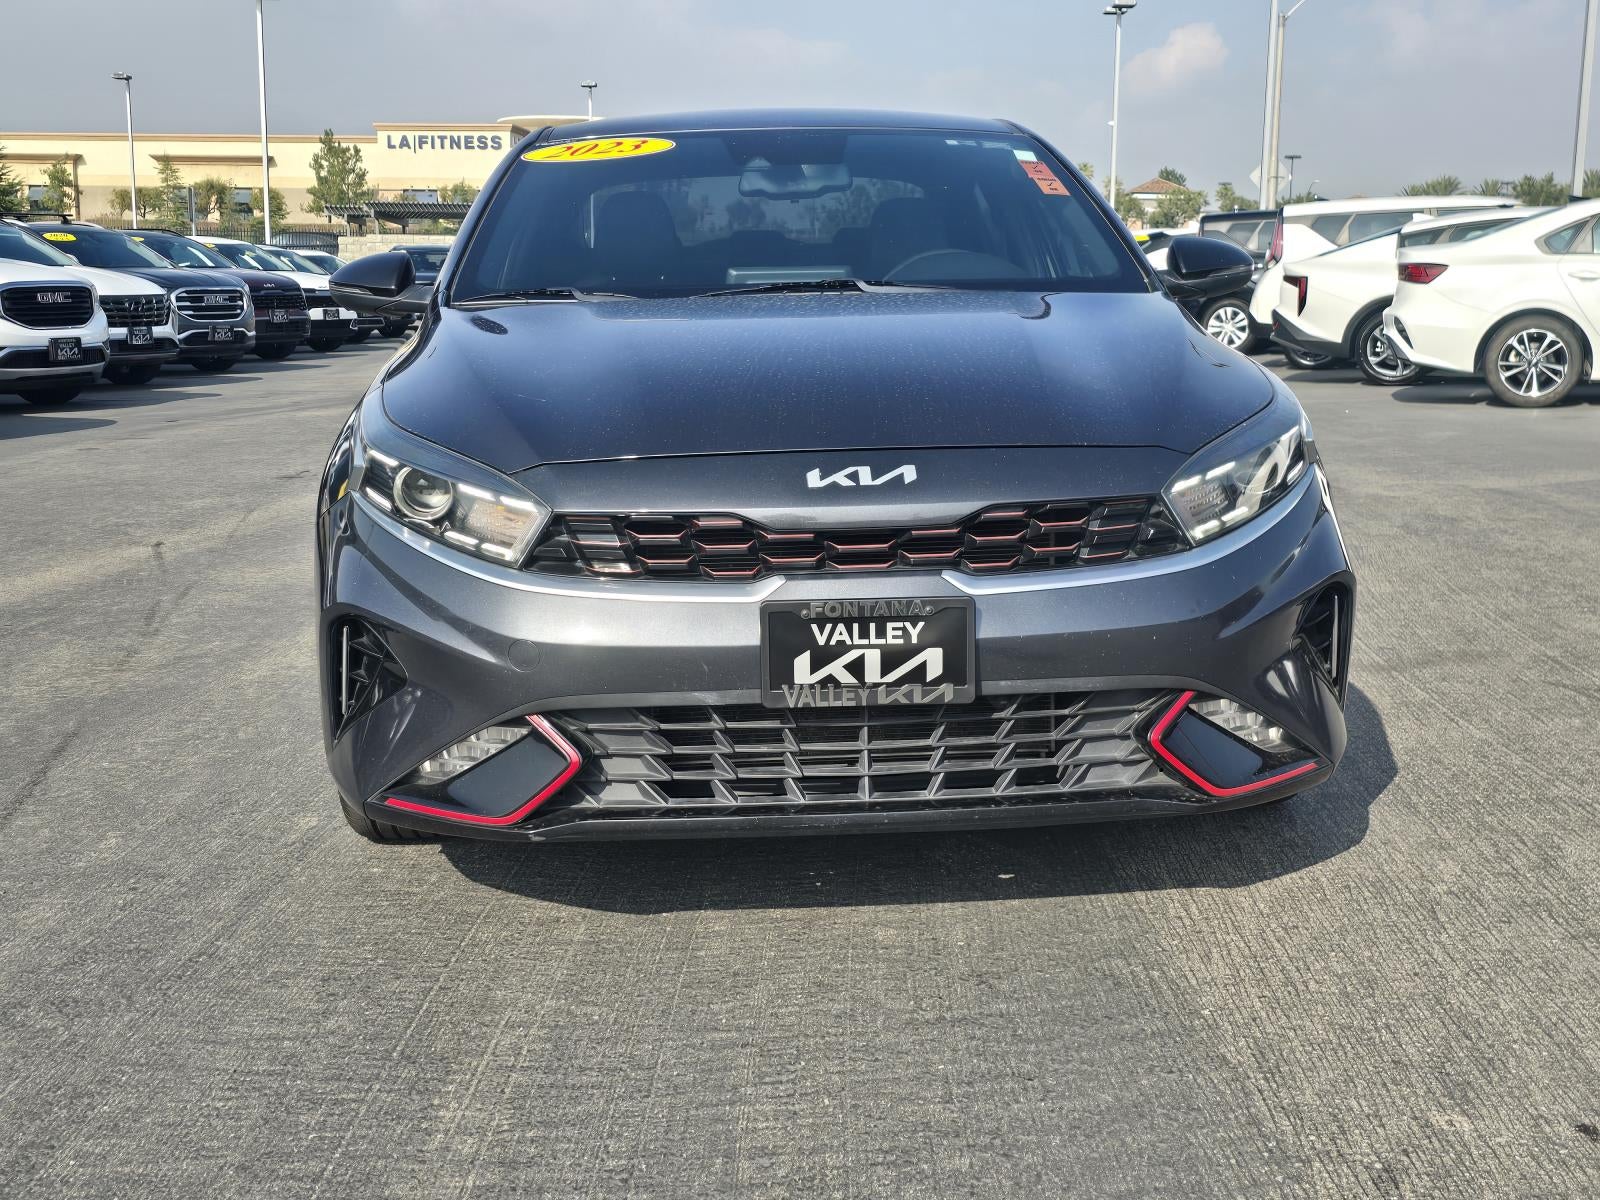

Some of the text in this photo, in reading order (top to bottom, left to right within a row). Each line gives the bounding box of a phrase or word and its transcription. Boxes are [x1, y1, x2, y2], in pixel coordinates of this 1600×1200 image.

[543, 139, 649, 159] 2023
[37, 292, 72, 304] GMC
[57, 347, 79, 356] KIA
[806, 464, 918, 488] KIA
[809, 600, 926, 618] FONTANA
[811, 622, 925, 645] VALLEY
[793, 647, 944, 684] KIA
[781, 683, 954, 708] VALLEY KIA
